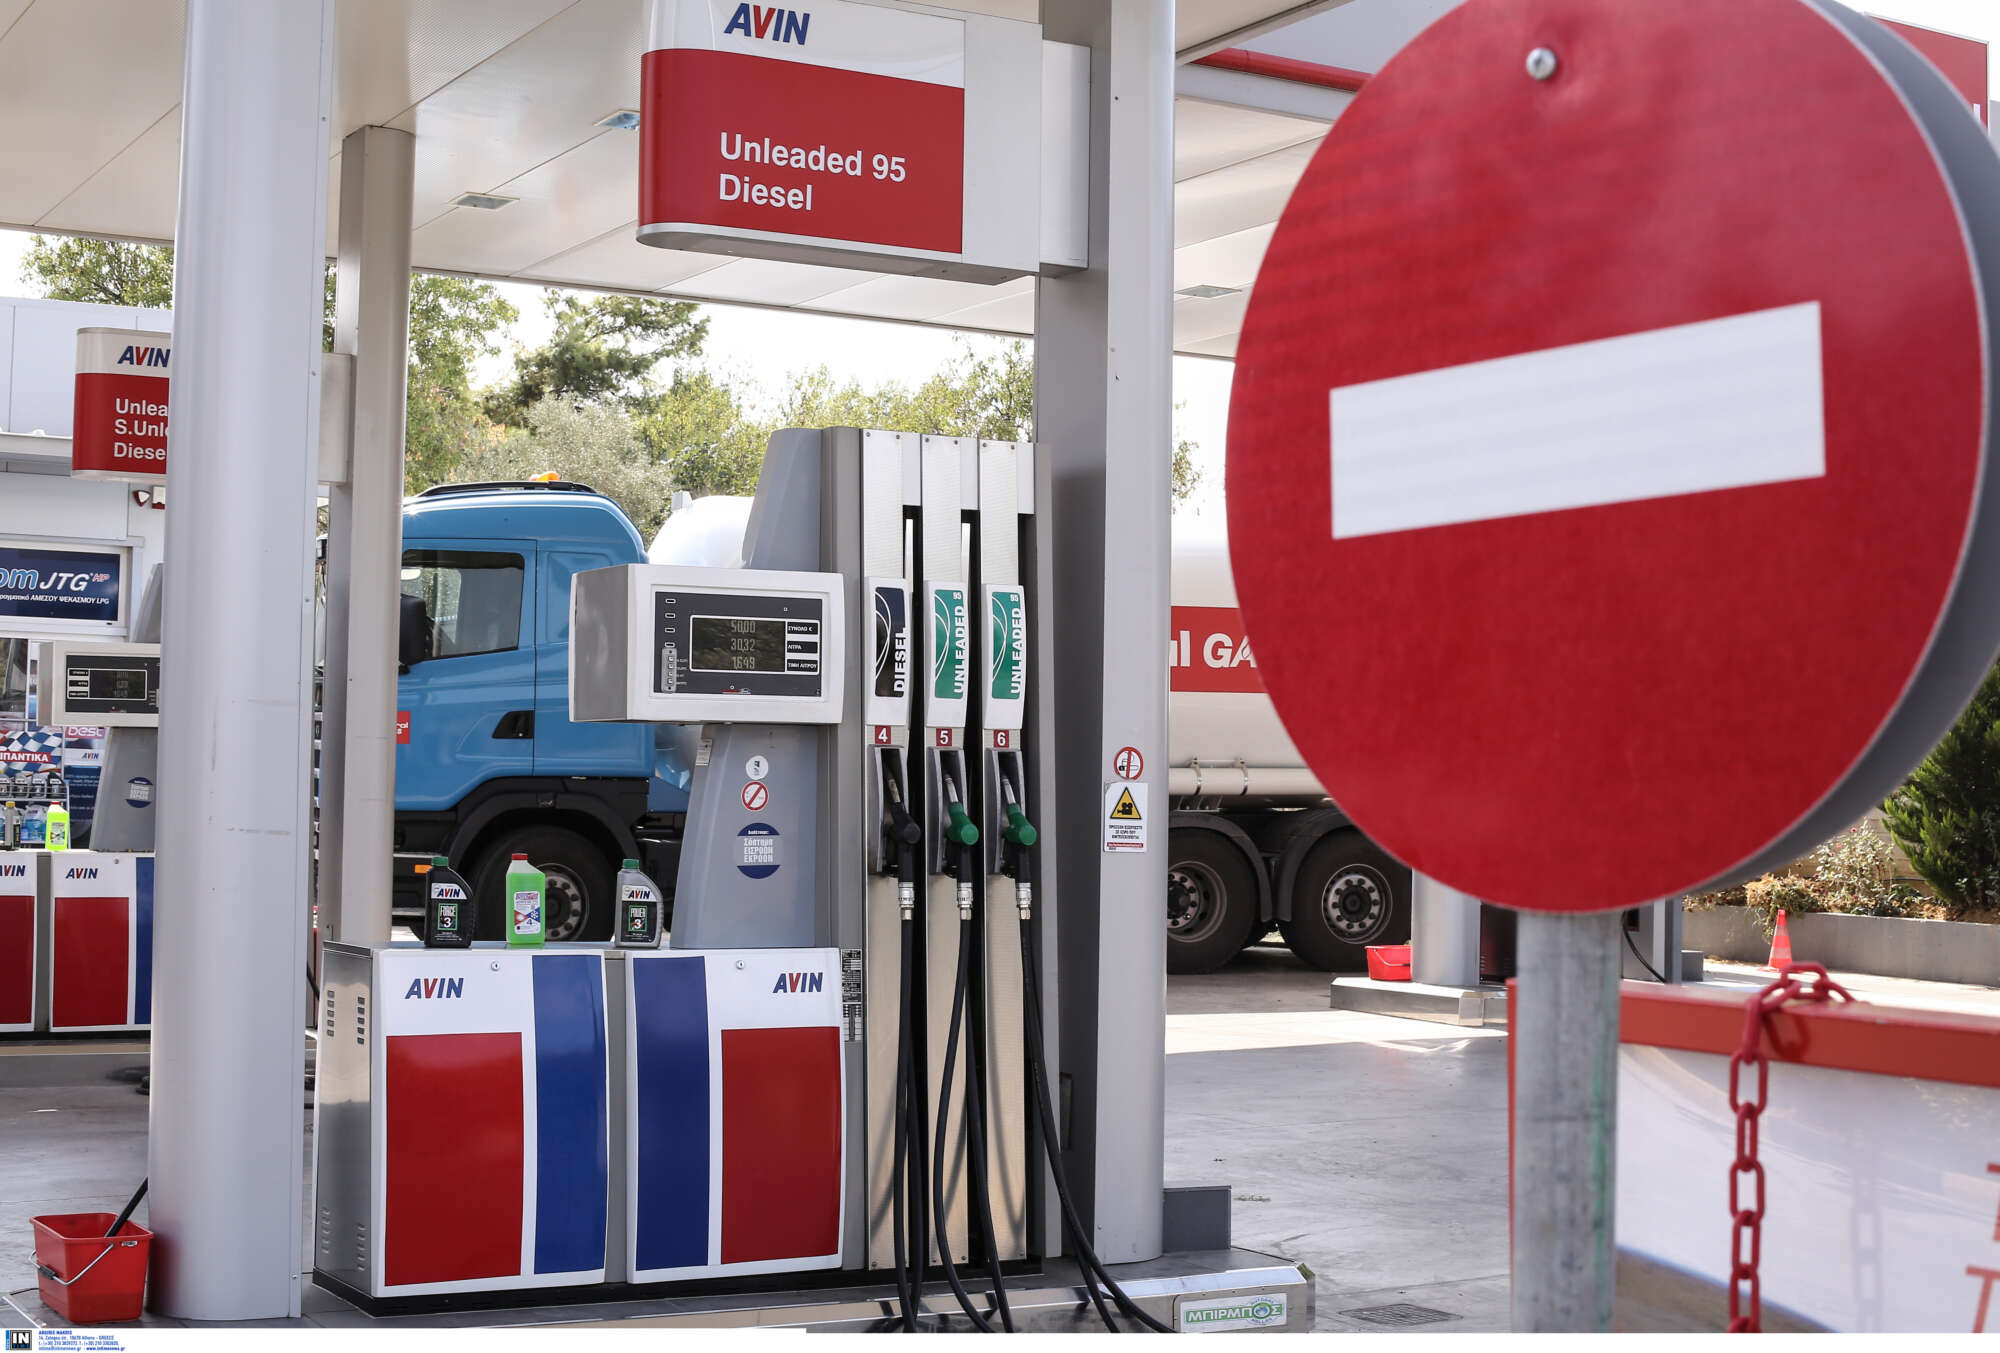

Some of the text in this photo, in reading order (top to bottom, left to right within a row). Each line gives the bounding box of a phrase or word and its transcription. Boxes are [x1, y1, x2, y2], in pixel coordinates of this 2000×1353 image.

[724, 3, 810, 45] AVIN
[721, 132, 906, 182] Unleaded 95
[719, 173, 813, 210] Diesel
[117, 345, 170, 367] AVIN
[114, 442, 166, 460] Diese
[40, 572, 89, 591] JTG
[954, 605, 966, 693] UNLEADED
[1010, 607, 1022, 693] UNLEADED
[894, 627, 906, 692] DIESEL
[878, 728, 888, 742] 4
[940, 731, 949, 745] 5
[997, 732, 1006, 746] 6
[82, 752, 99, 760] AVIN
[66, 868, 98, 879] AVIN
[437, 888, 460, 898] AVIN
[628, 890, 650, 899] AVIN
[443, 917, 451, 928] 3
[405, 977, 464, 999] AVIN
[772, 972, 823, 993] AVIN
[1188, 1301, 1280, 1322] ΜΠΙΡΜΠΟΣ
